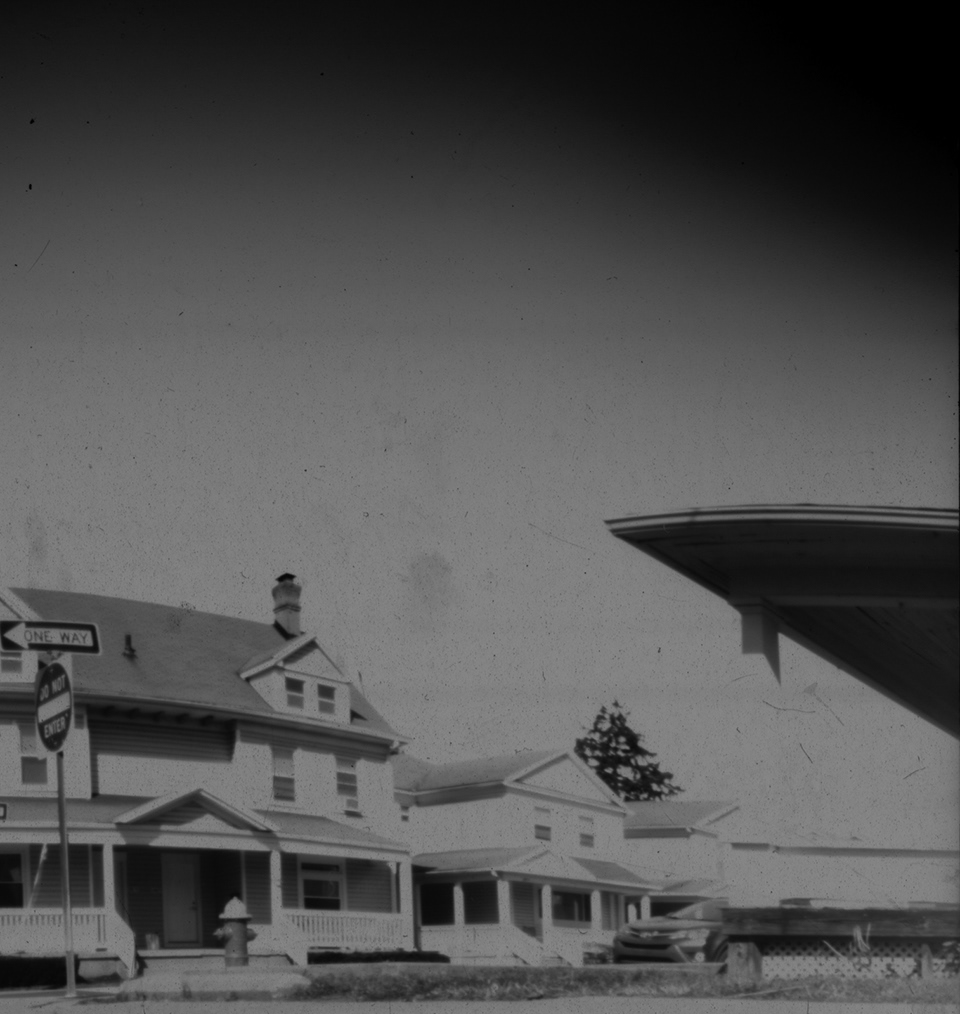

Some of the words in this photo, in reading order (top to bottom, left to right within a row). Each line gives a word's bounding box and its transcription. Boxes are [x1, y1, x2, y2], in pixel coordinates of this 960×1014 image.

[24, 630, 52, 643] ONE
[60, 631, 88, 644] WAY
[52, 674, 66, 694] NOT
[44, 716, 66, 739] ENTER
